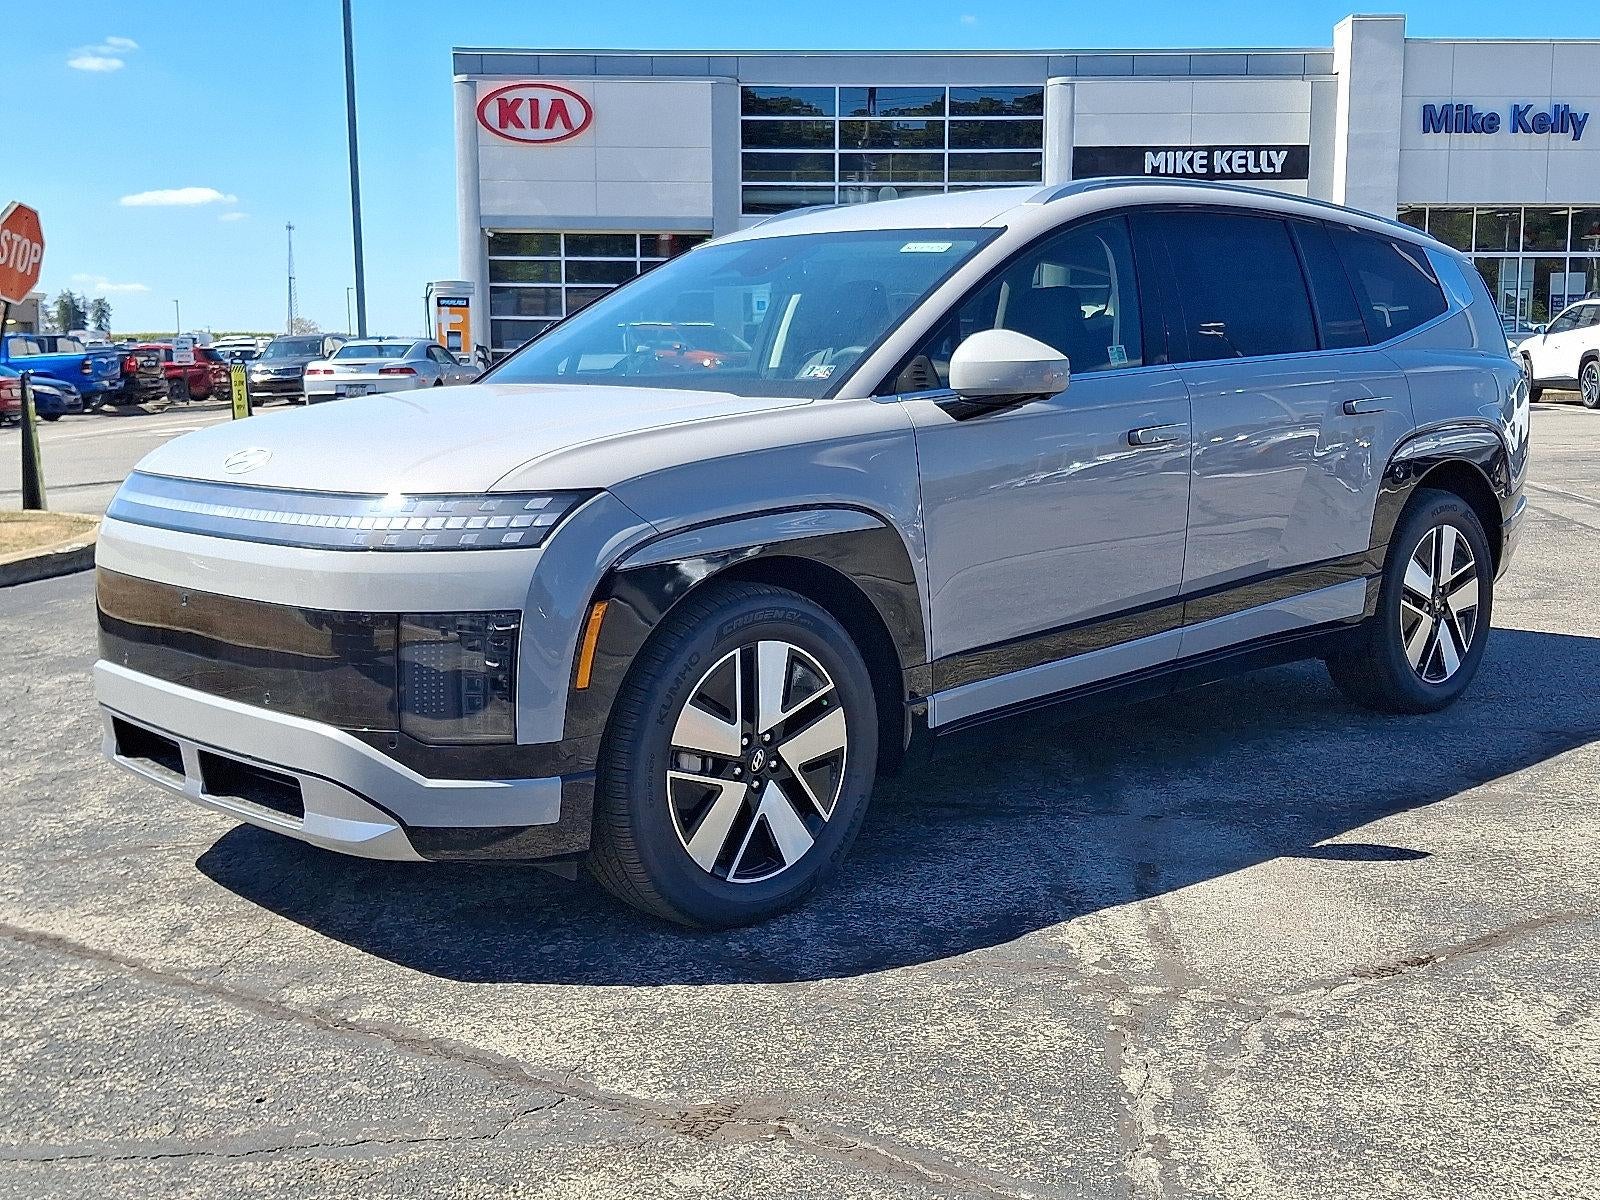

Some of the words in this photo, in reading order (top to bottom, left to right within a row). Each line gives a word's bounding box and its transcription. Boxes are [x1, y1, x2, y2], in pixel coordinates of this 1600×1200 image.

[496, 97, 574, 130] KIA
[1422, 103, 1501, 135] Mike
[1510, 103, 1590, 142] Kelly
[1144, 150, 1208, 174] MIKE
[1213, 150, 1288, 174] KELLY
[0, 229, 42, 276] STOP
[656, 651, 700, 726] KUMHO
